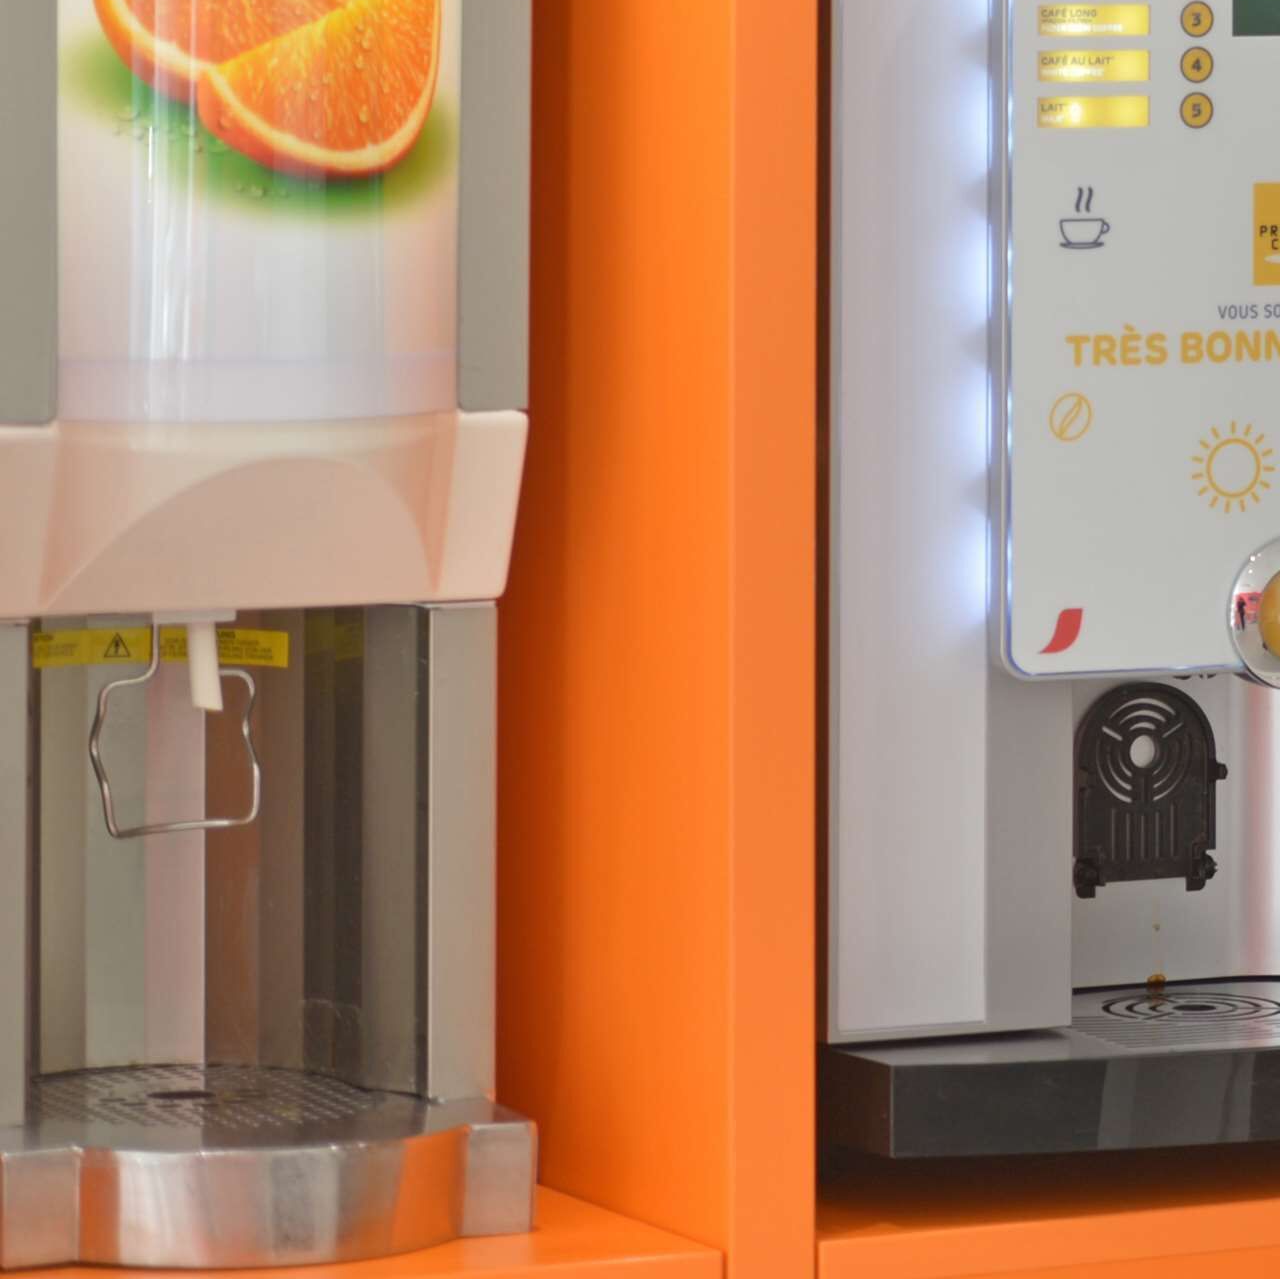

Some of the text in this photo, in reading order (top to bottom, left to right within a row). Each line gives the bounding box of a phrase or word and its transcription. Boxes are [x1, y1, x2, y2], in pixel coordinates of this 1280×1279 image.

[1041, 8, 1097, 18] CAFÉ LONG
[1191, 13, 1202, 27] 3
[1041, 55, 1111, 65] CAFÉ AU LAIT
[1191, 59, 1202, 73] 4
[1041, 103, 1063, 112] LAIT
[1191, 103, 1202, 118] 5
[1217, 303, 1258, 320] vous
[1065, 324, 1168, 367] TRÈS
